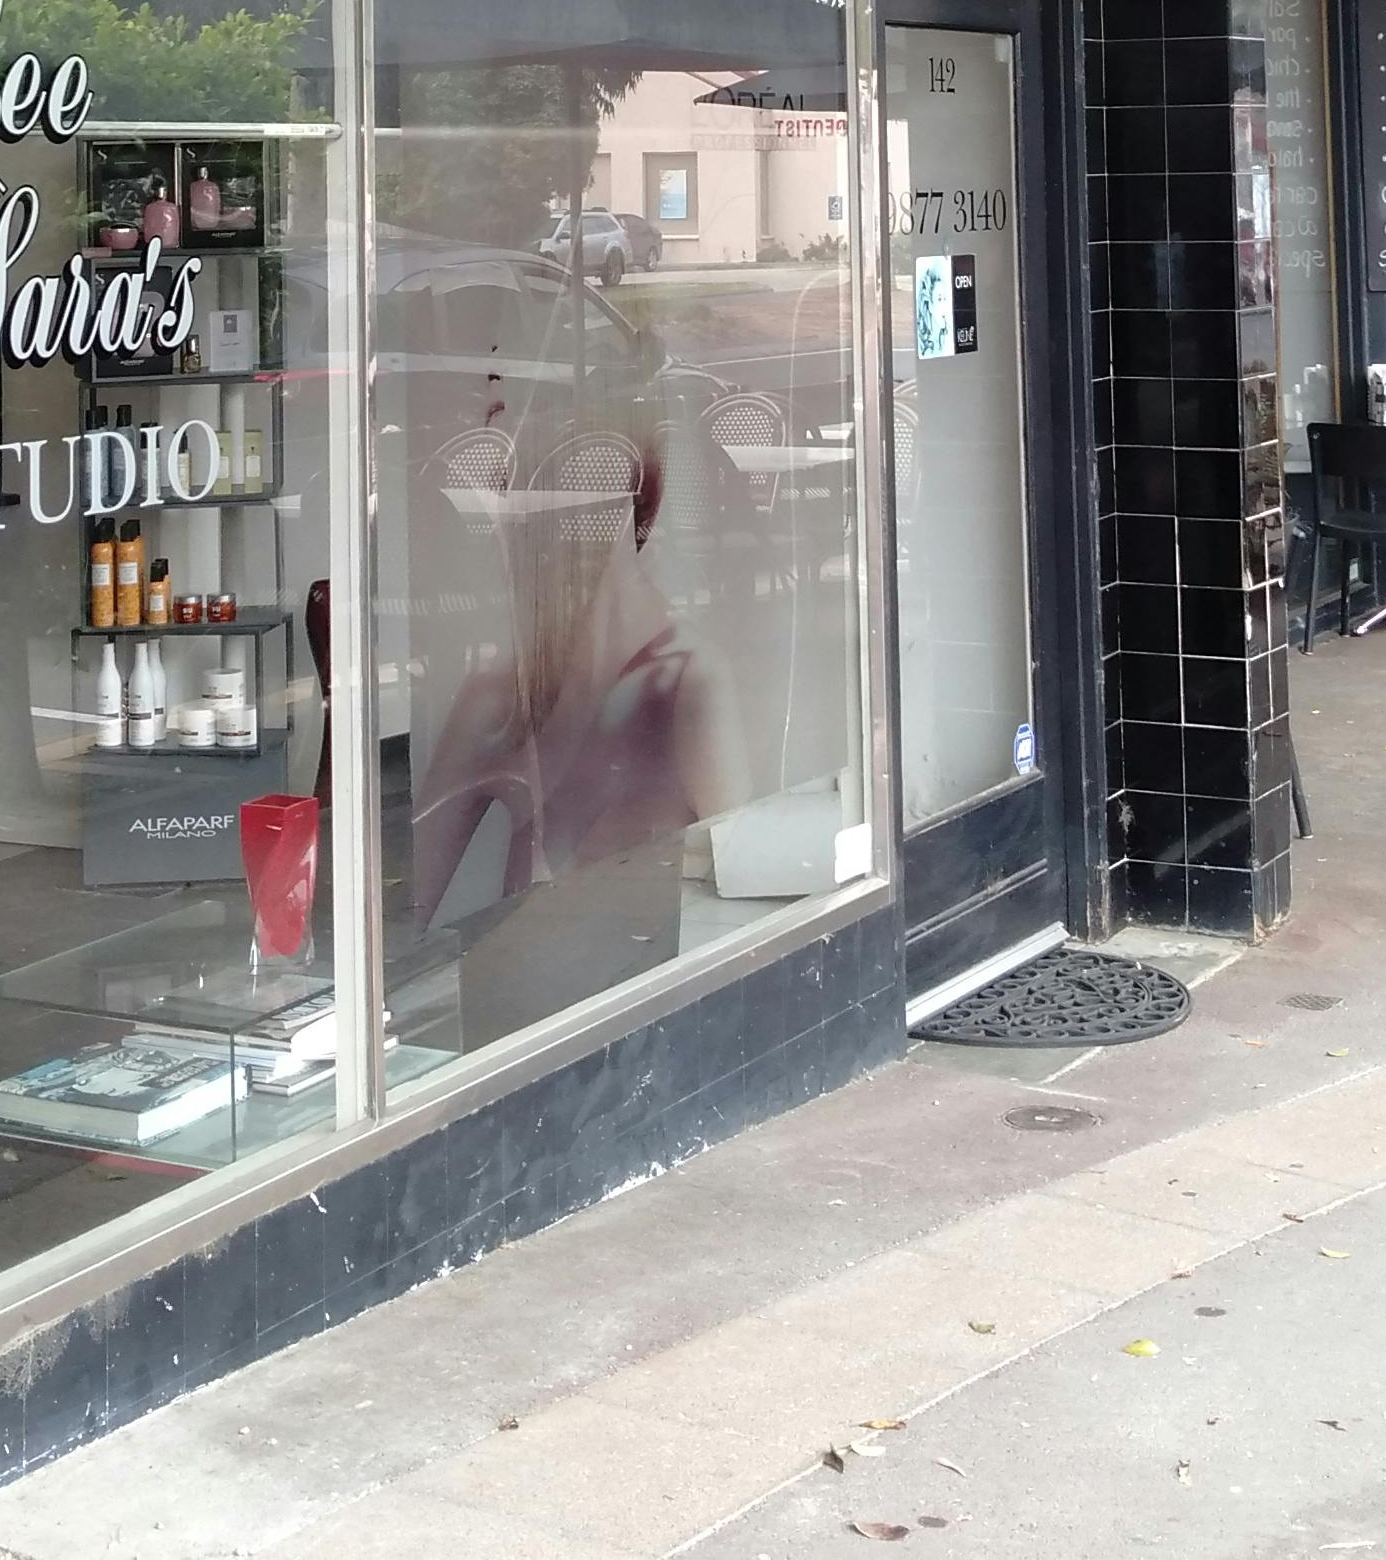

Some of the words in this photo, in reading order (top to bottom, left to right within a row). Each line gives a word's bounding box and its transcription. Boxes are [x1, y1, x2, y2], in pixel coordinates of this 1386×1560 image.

[928, 56, 956, 93] 142
[954, 188, 1007, 233] 3140
[954, 274, 972, 289] OPEN
[128, 814, 235, 832] ALFAPARF
[146, 830, 217, 840] MILANO
